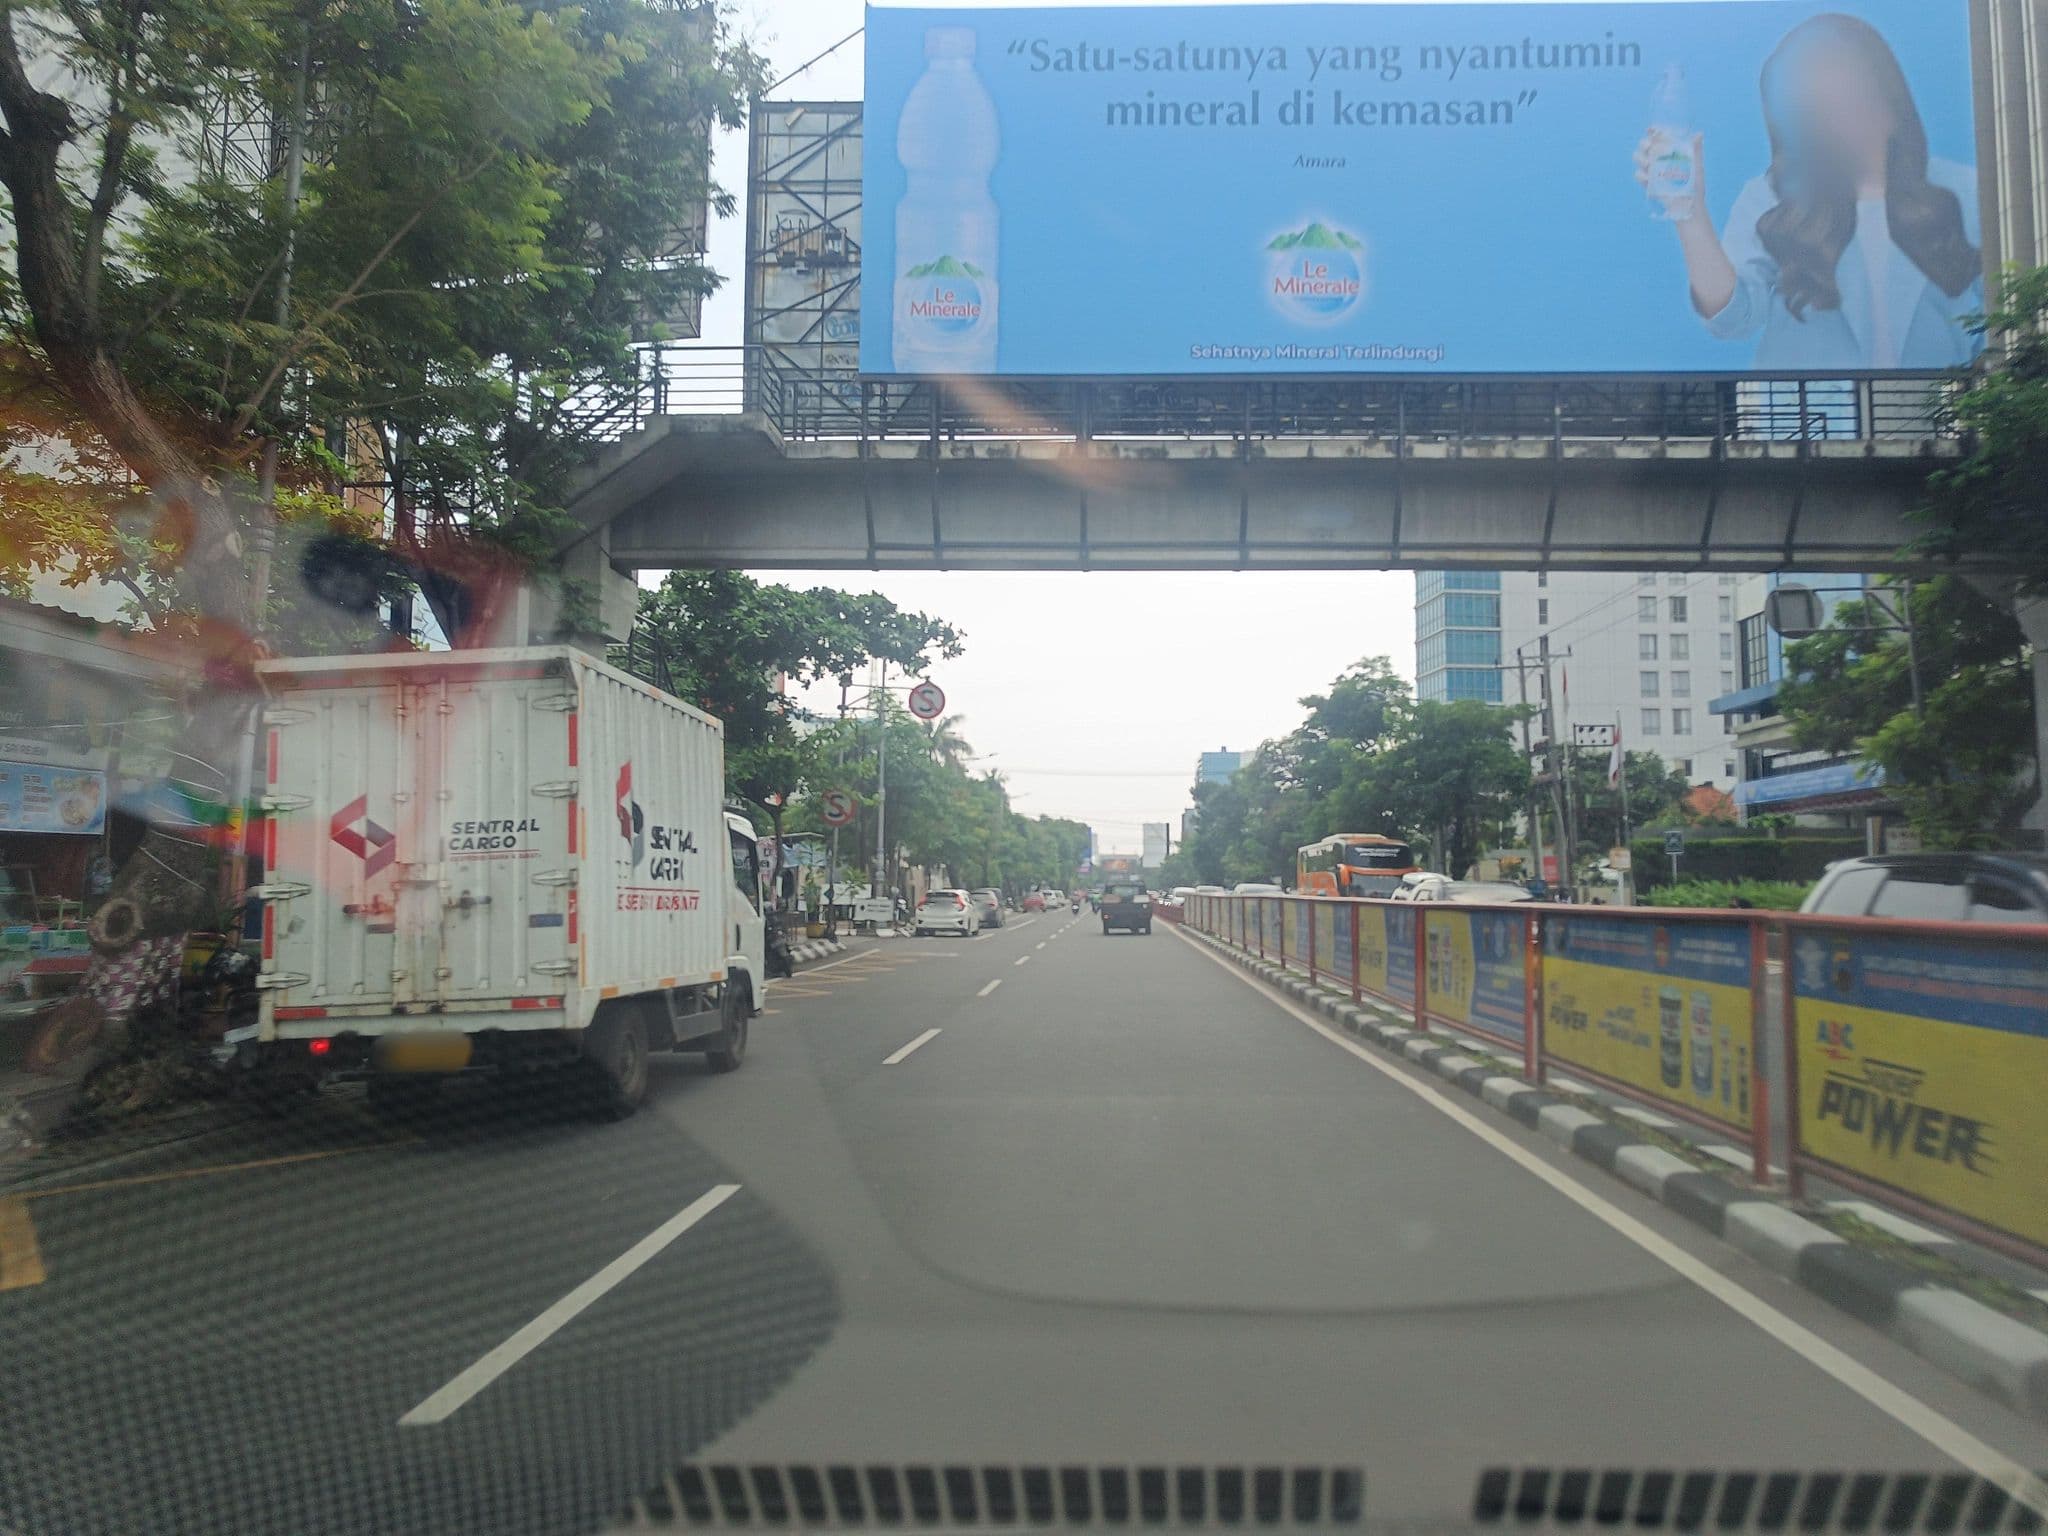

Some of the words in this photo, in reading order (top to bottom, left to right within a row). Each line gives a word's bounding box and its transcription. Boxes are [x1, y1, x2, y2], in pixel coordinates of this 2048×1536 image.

[1306, 45, 1403, 82] yang
[1419, 31, 1641, 82] nyantumin
[1106, 89, 1259, 126] mineral
[1278, 89, 1315, 126] di
[1294, 154, 1346, 168] Amara
[1304, 260, 1327, 279] Le
[935, 287, 955, 303] Le
[1274, 277, 1360, 295] Minerale
[910, 301, 981, 317] Minerale
[1190, 344, 1271, 361] Sehatnya
[1276, 344, 1340, 360] Mineral
[1346, 344, 1444, 362] Terlindungi
[451, 818, 540, 834] SENTRAL
[448, 835, 516, 850] CARGO
[1816, 1019, 1855, 1049] ABC
[1817, 1078, 1994, 1174] POWER
